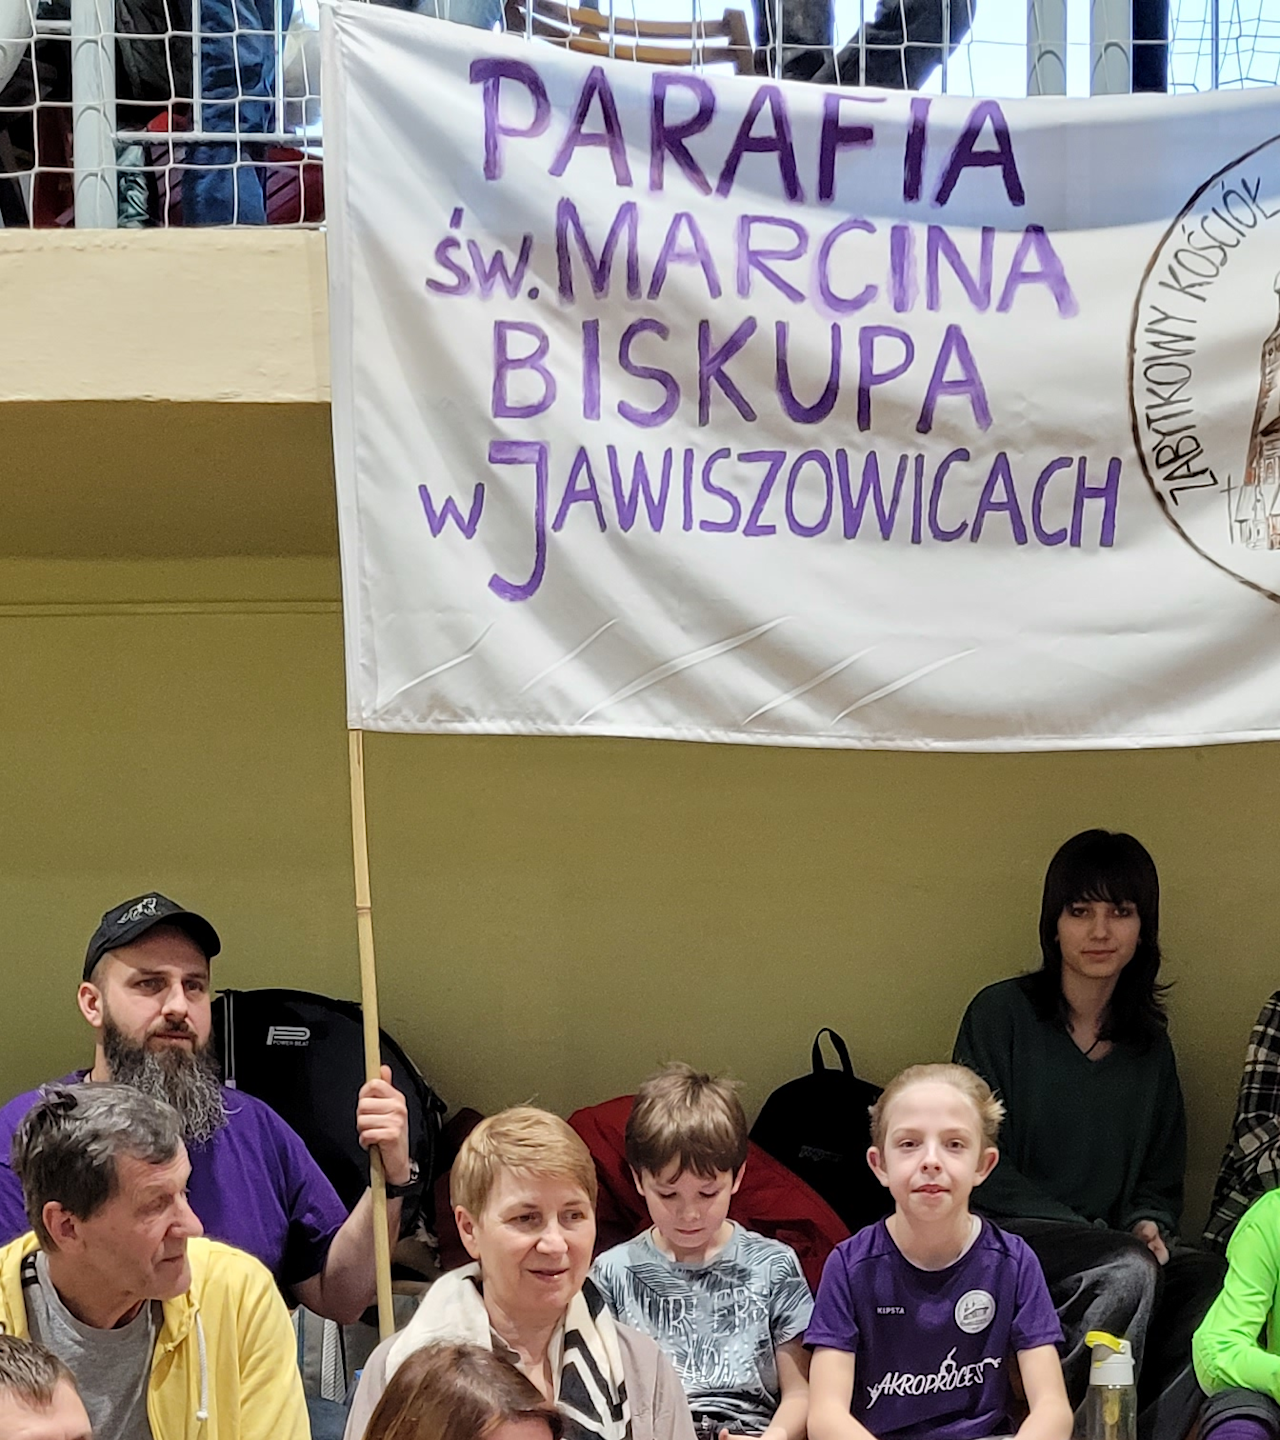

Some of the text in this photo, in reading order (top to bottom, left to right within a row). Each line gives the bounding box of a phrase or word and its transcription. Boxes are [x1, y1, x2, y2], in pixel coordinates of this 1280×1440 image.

[470, 56, 1026, 207] PARAFIA
[426, 197, 1079, 319] św. MARCINA
[491, 316, 994, 433] BISKUPA
[1142, 304, 1218, 506] ZABYTKOWY
[487, 440, 1121, 602] JAWISZOWICACH
[877, 1306, 905, 1315] KIPSTA
[870, 1361, 987, 1402] AKROPROCES
